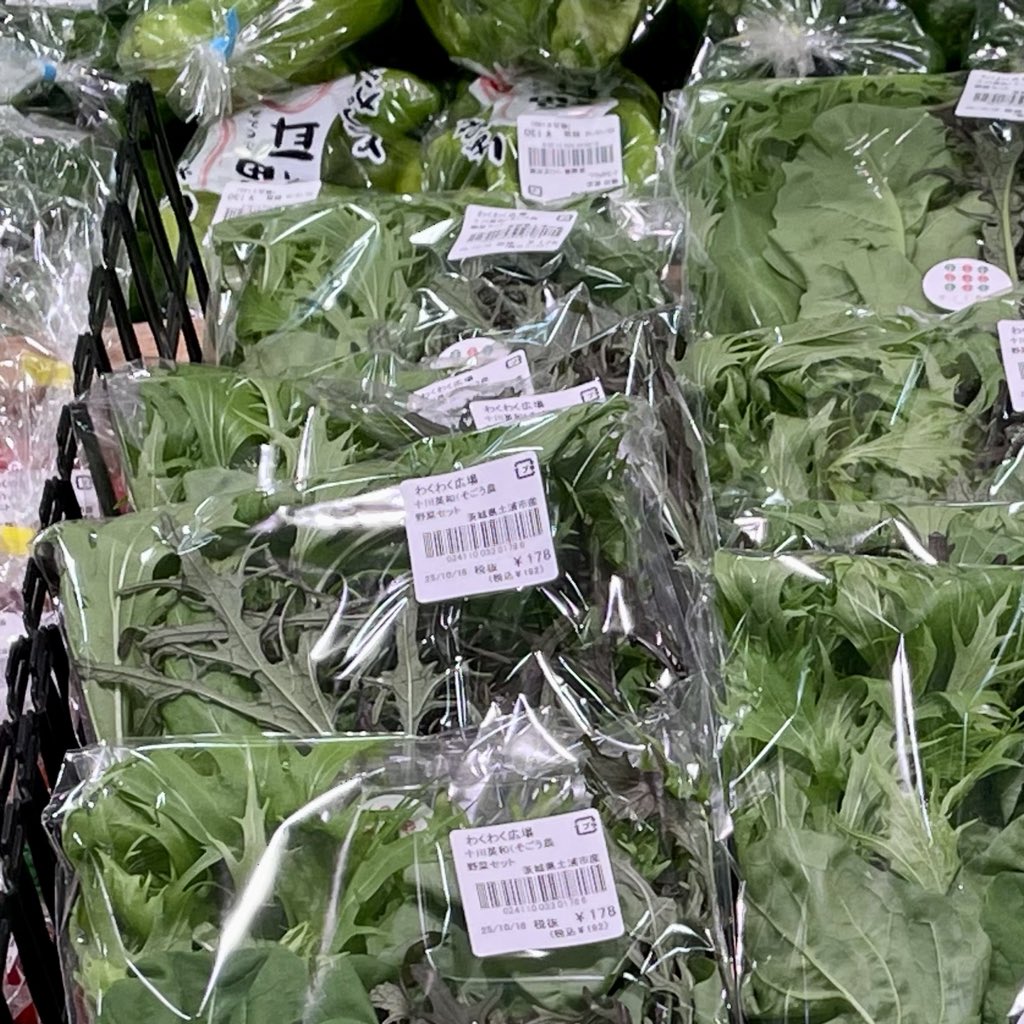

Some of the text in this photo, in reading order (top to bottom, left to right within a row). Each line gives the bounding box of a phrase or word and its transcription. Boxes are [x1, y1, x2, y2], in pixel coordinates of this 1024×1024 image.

[485, 400, 544, 412] わくわく広場
[416, 474, 478, 495] わくわく広場
[467, 827, 533, 845] わくわく広場
